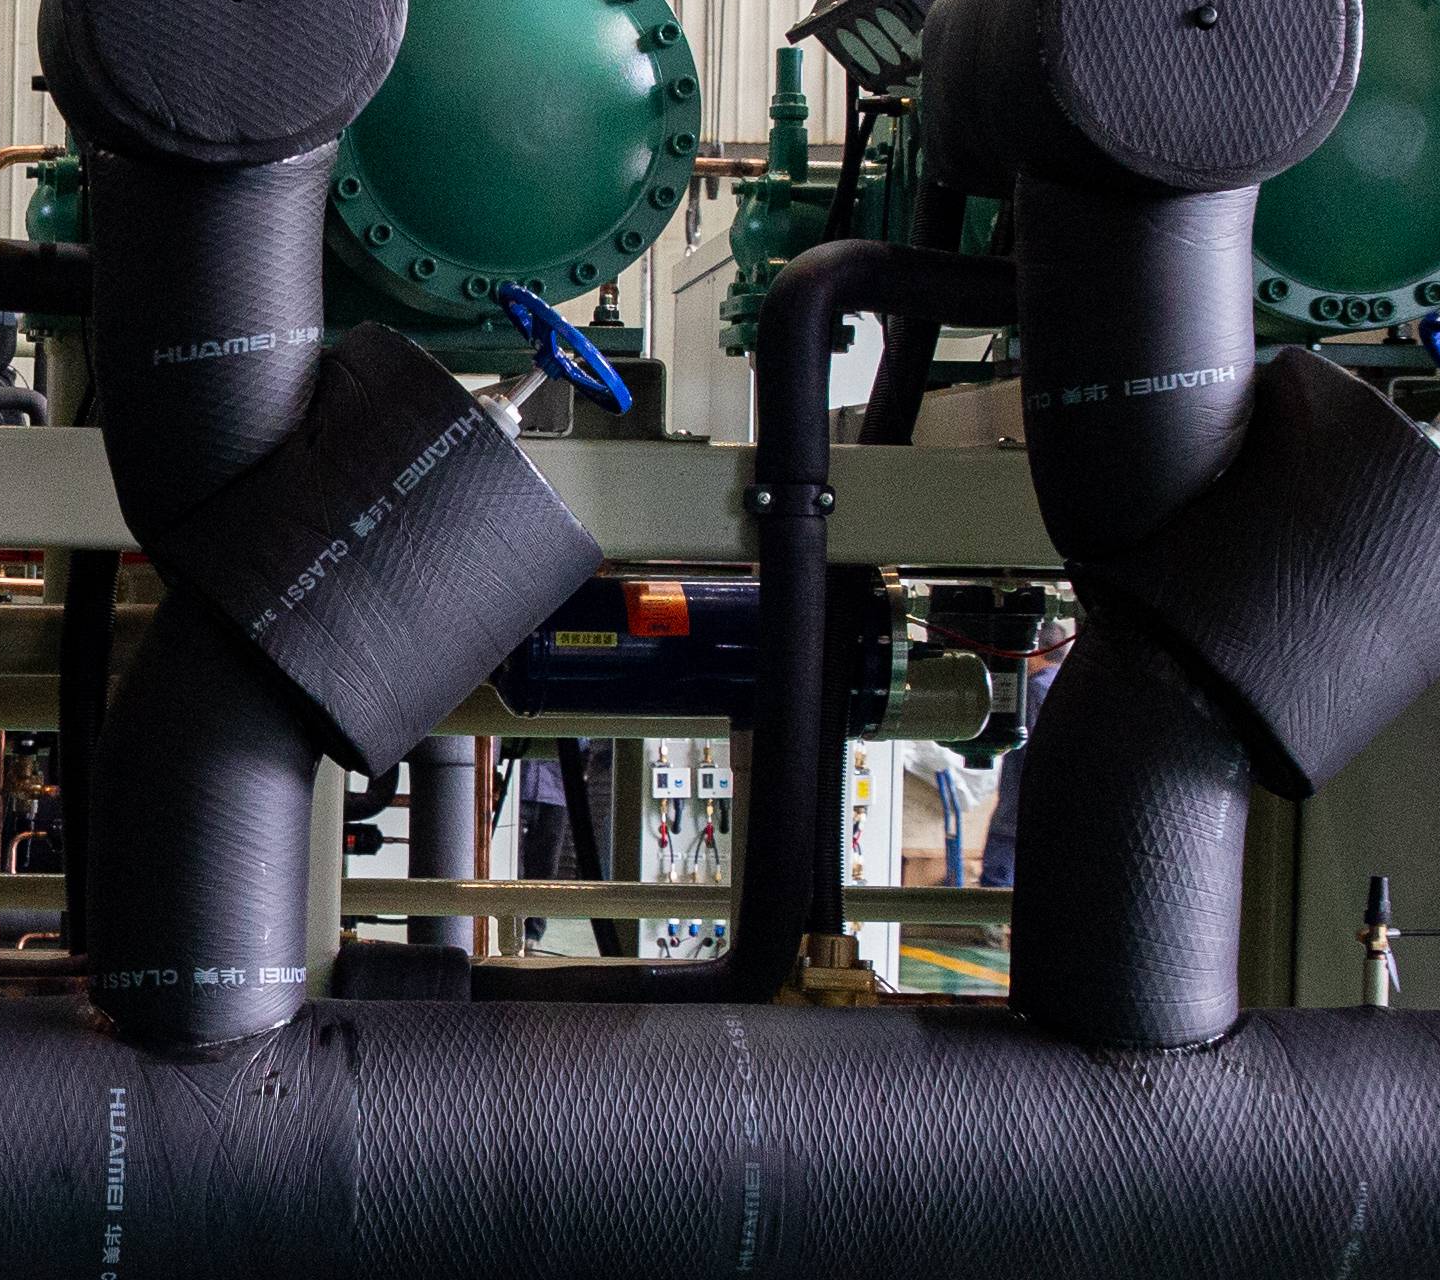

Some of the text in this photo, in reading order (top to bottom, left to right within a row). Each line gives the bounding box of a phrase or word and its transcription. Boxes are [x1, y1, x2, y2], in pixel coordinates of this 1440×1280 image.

[153, 331, 276, 366] HUAMEI
[1125, 365, 1236, 397] HUAMEI
[392, 406, 484, 496] HUAMEI
[349, 495, 393, 539] 华美
[280, 540, 350, 610] CLASS1
[194, 967, 246, 985] 华美
[107, 1087, 126, 1211] HUAMEI
[102, 1224, 123, 1264] 华美
